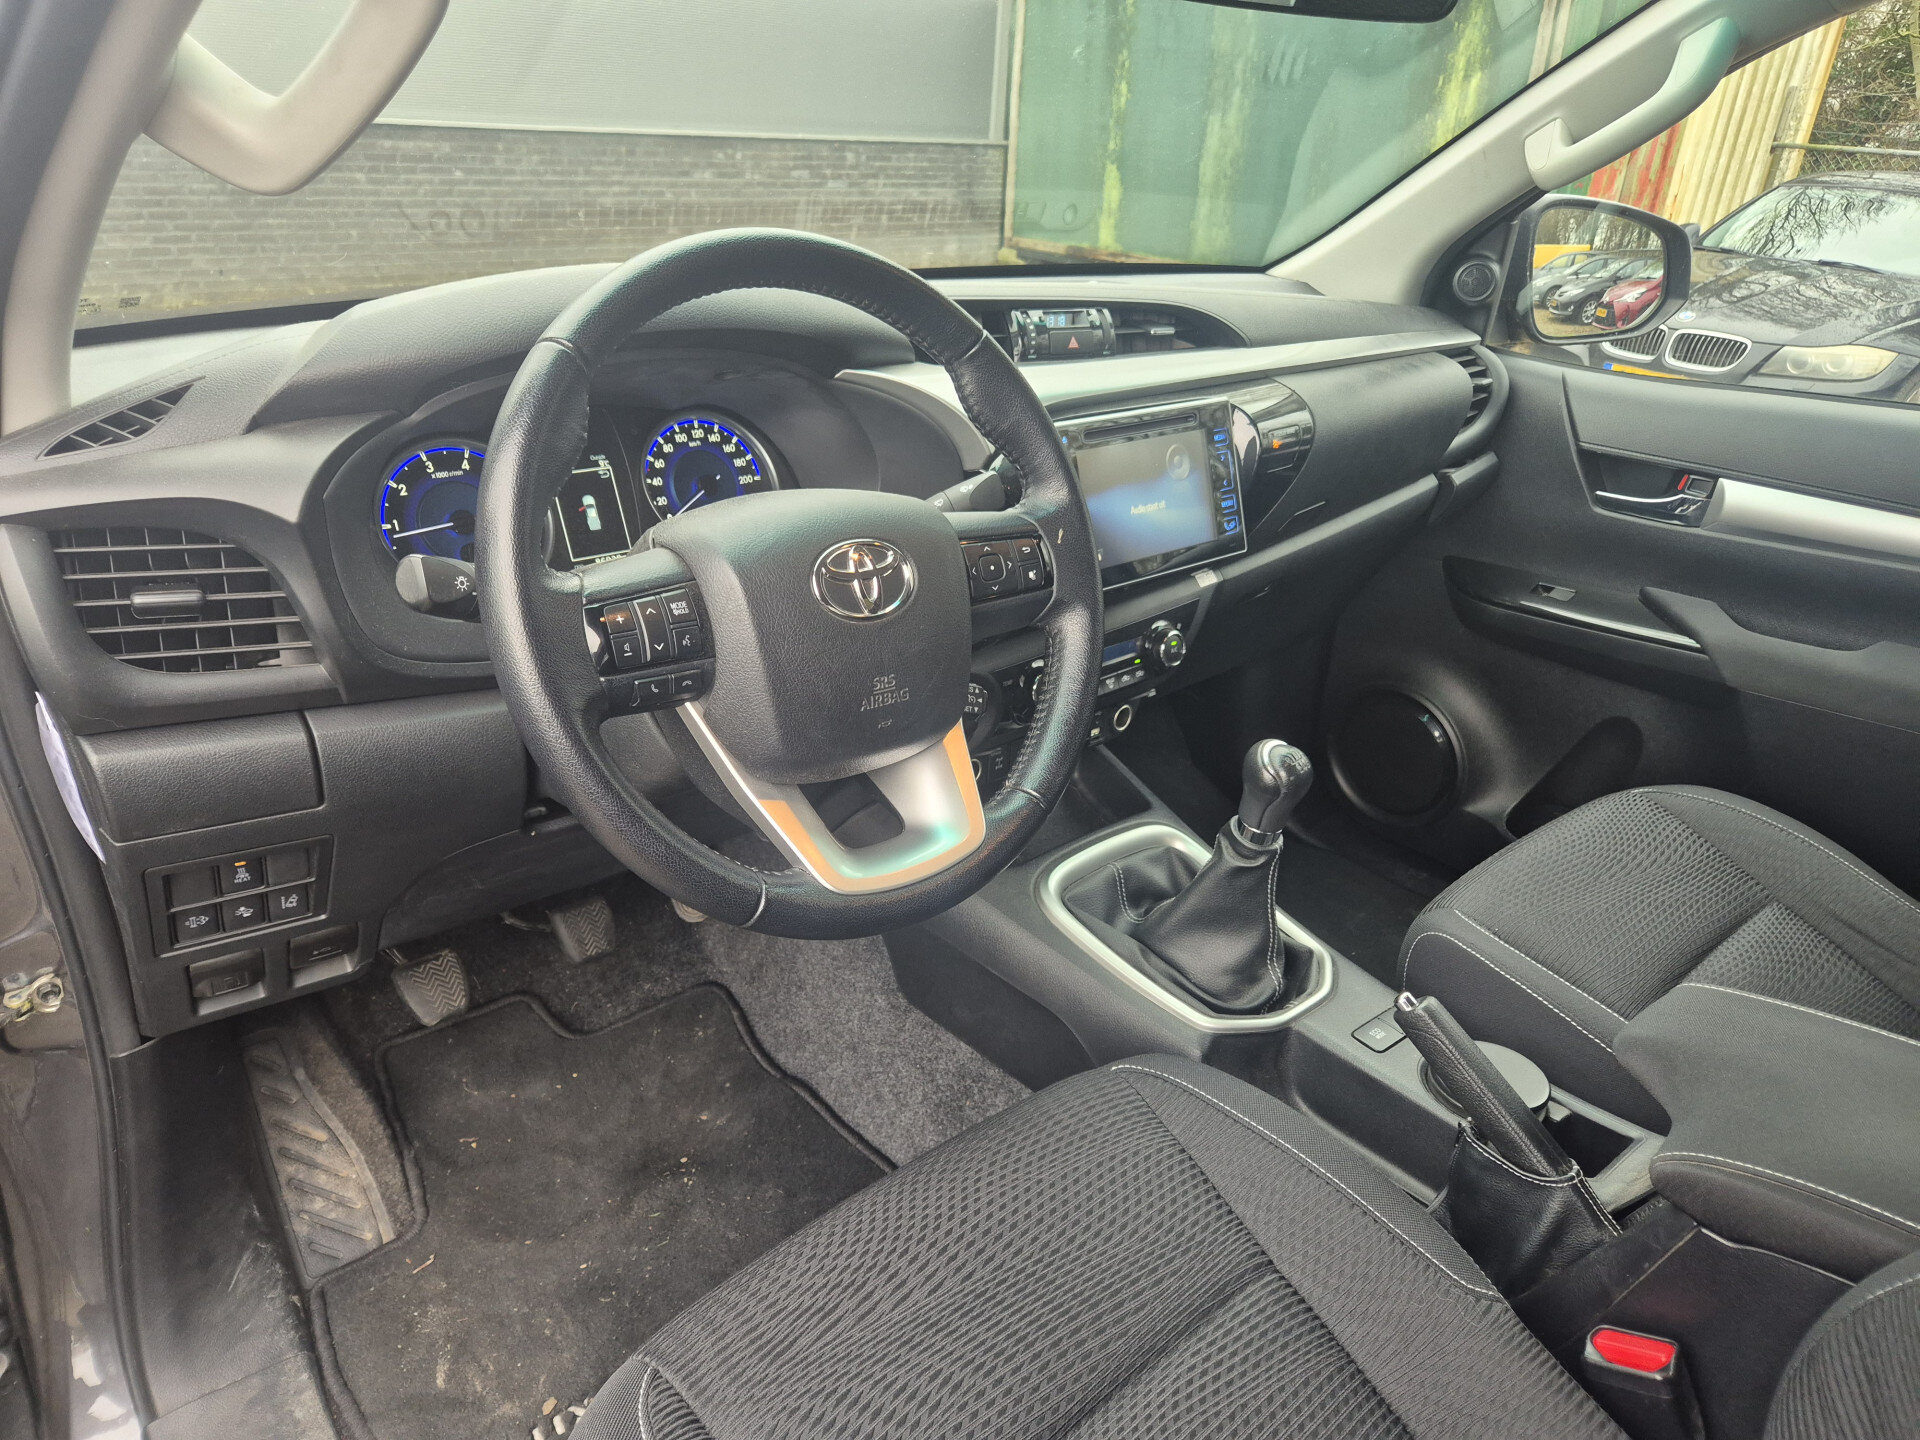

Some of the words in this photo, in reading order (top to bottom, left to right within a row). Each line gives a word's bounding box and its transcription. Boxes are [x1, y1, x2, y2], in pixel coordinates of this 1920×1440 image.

[674, 433, 688, 443] 100
[691, 428, 704, 438] 120
[707, 433, 721, 442] 140
[662, 443, 674, 453] 80
[722, 443, 736, 453] 160
[425, 460, 434, 473] 3
[461, 459, 470, 470] 4
[654, 458, 665, 469] 60
[733, 457, 747, 467] 180
[651, 477, 663, 486] 40
[738, 475, 753, 485] 200
[398, 483, 408, 496] 2
[656, 496, 668, 506] 20
[392, 519, 399, 531] 1
[670, 601, 688, 610] MODE
[873, 674, 896, 690] SRS
[860, 687, 910, 712] AIRBAG
[1369, 1027, 1381, 1037] ECO
